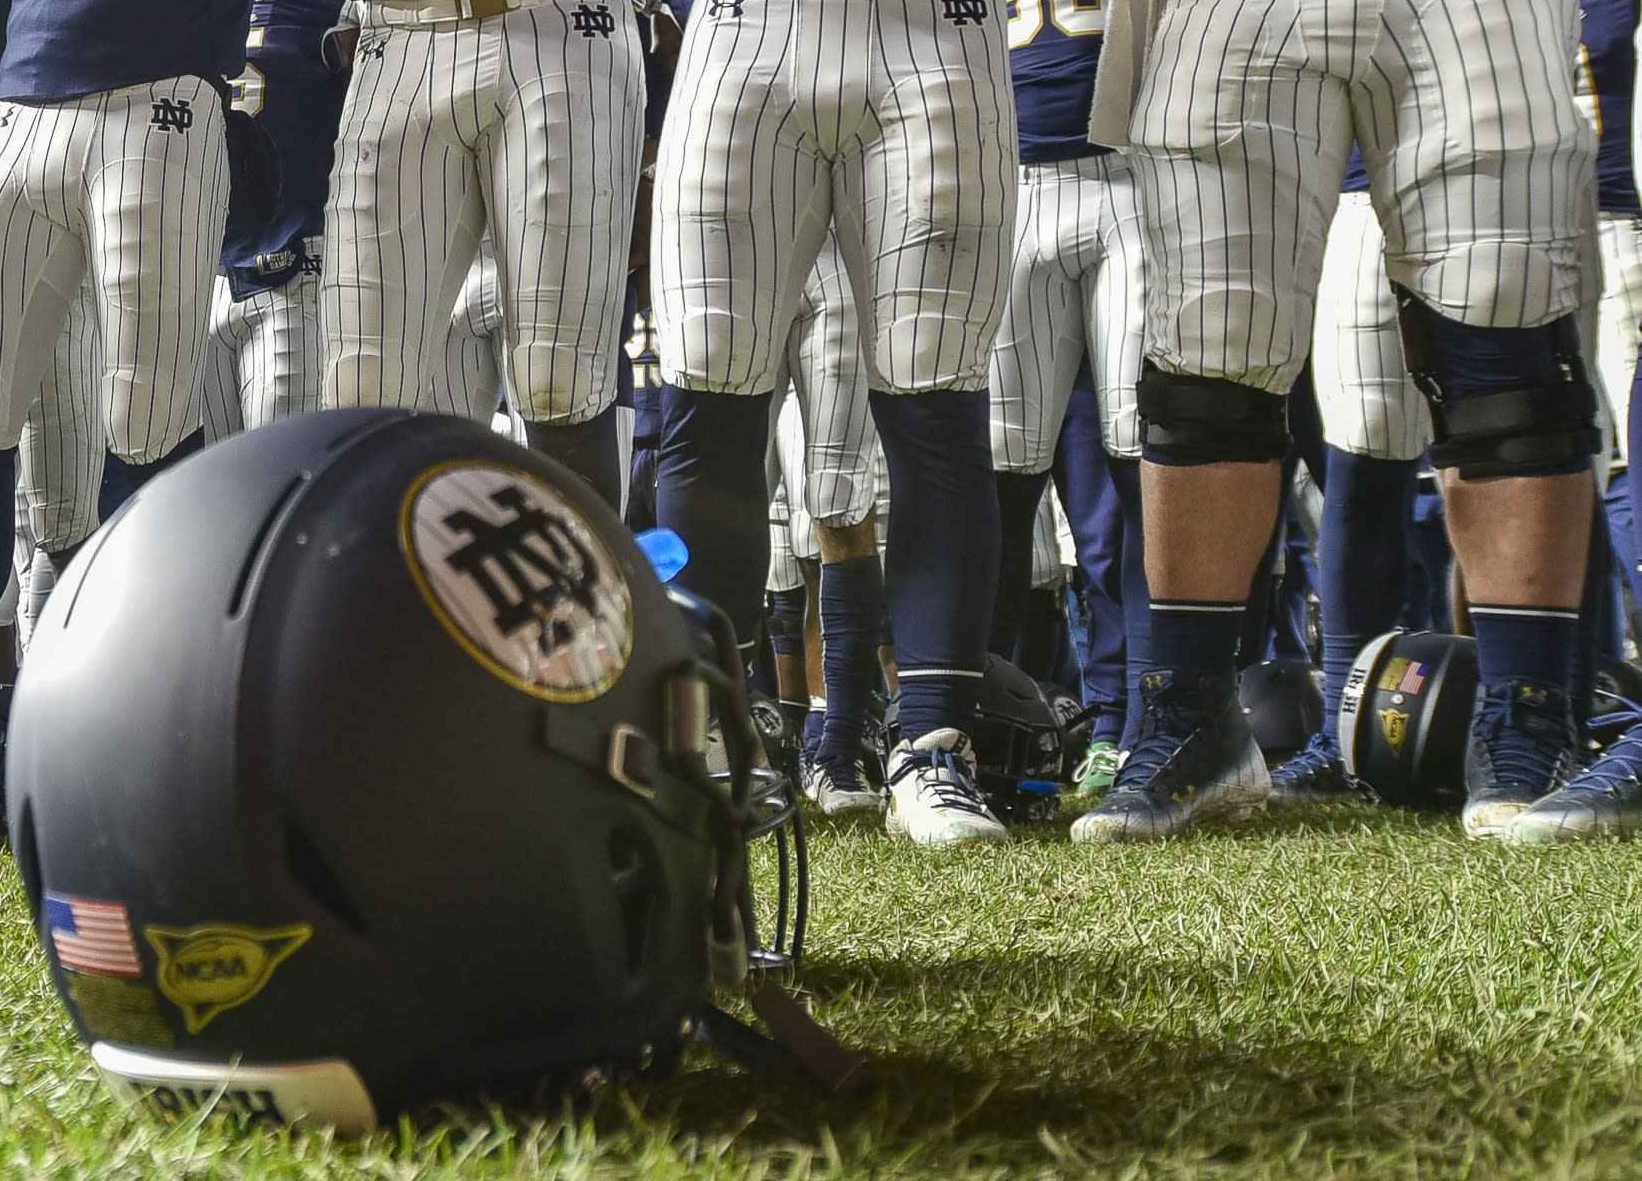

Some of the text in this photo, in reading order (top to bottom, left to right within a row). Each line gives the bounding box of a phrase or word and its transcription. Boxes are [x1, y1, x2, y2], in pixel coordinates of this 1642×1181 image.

[570, 1, 616, 39] ND
[152, 97, 193, 134] ND
[176, 956, 249, 979] NCAA
